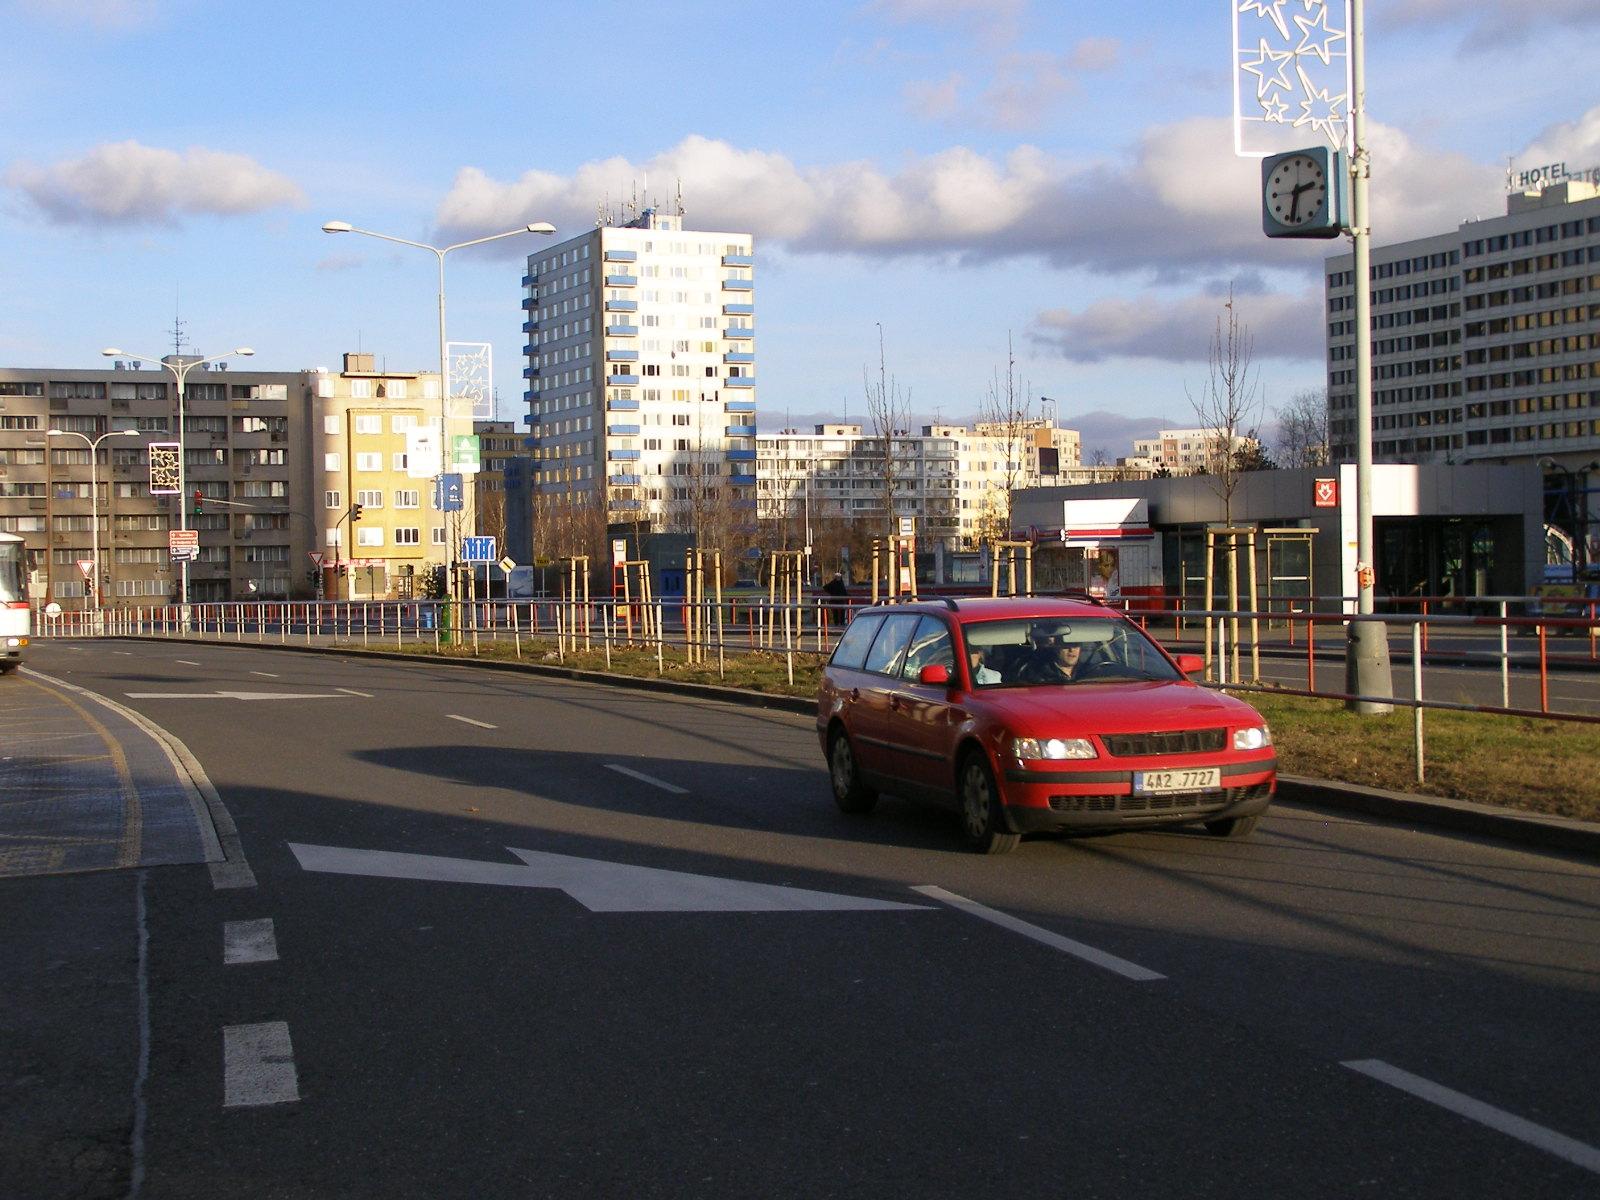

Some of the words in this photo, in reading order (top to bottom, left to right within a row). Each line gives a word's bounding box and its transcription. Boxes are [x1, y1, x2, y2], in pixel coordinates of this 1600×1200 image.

[1520, 162, 1570, 186] HOTEL
[1146, 774, 1172, 788] 4A2
[1182, 771, 1214, 786] 7727
